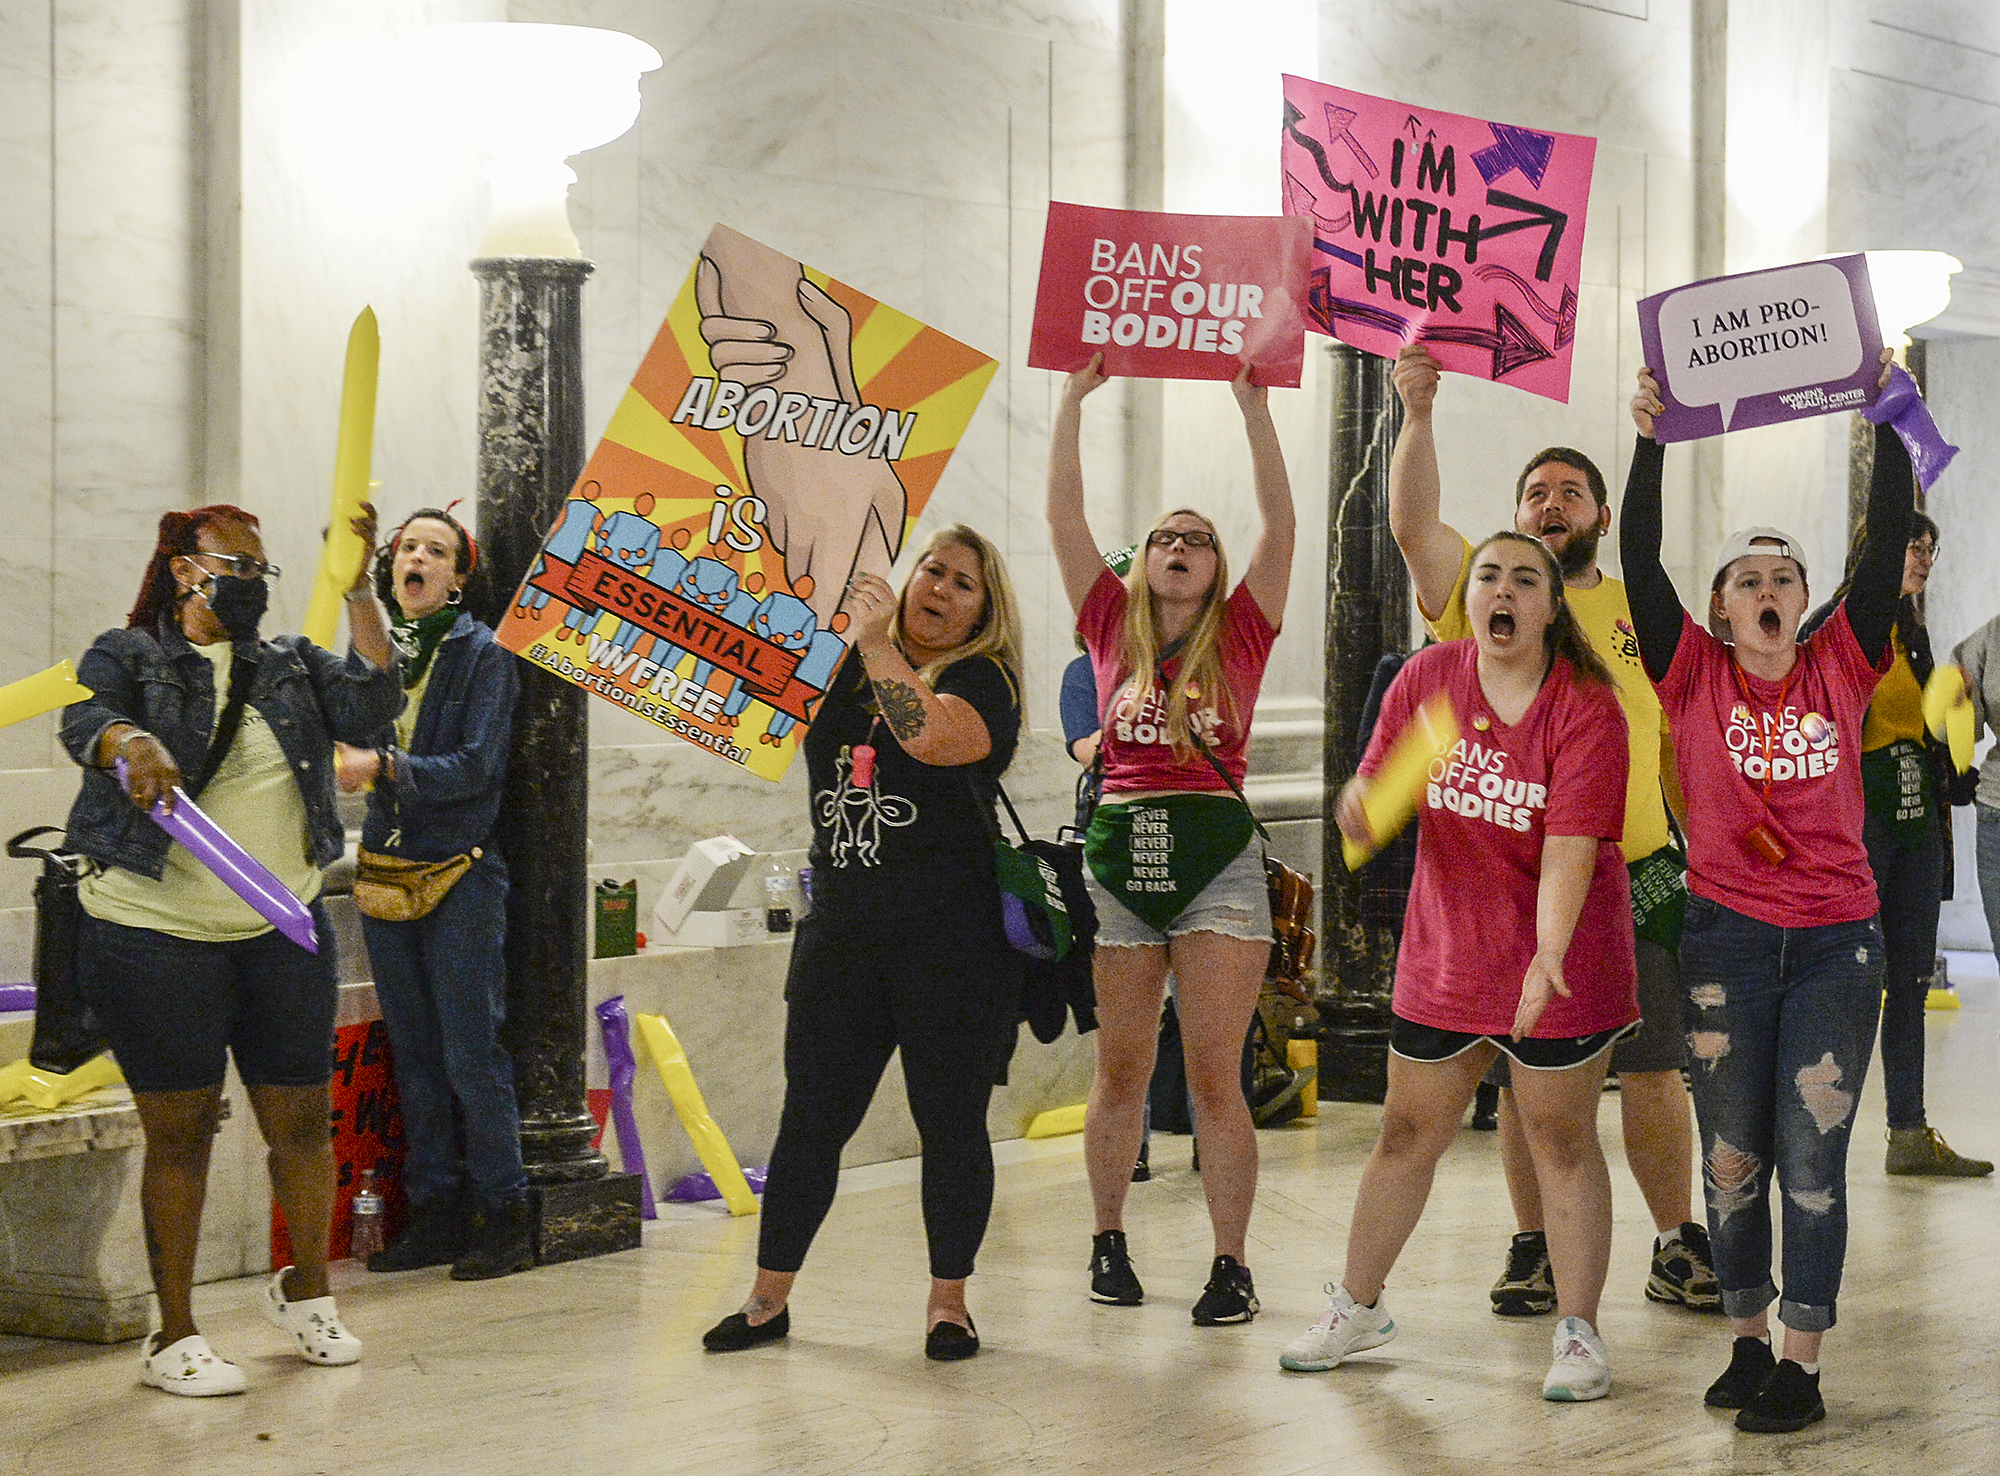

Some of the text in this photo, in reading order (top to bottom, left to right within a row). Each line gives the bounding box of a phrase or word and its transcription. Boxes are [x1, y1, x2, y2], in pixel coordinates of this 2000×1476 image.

[1352, 188, 1481, 265] WITH
[1090, 237, 1204, 281] BANS
[1365, 248, 1463, 314] HER
[1083, 273, 1265, 319] OFF OUR
[1691, 297, 1821, 339] I AM PRO-
[1081, 309, 1246, 356] BODIES
[1687, 323, 1828, 369] ABORTION!
[671, 375, 918, 462] ABORTION
[592, 571, 764, 677] ESSENTIAL
[529, 643, 752, 765] #AbortionIsEssential
[1428, 757, 1548, 809] OFF OUR
[1132, 808, 1169, 824] NEVER
[1132, 821, 1169, 834] NEVER
[1427, 782, 1534, 833] BODIES
[1132, 852, 1169, 865] NEVER
[1133, 836, 1169, 850] NEVER
[1125, 879, 1178, 893] GO BACK
[1132, 866, 1169, 879] NEVER
